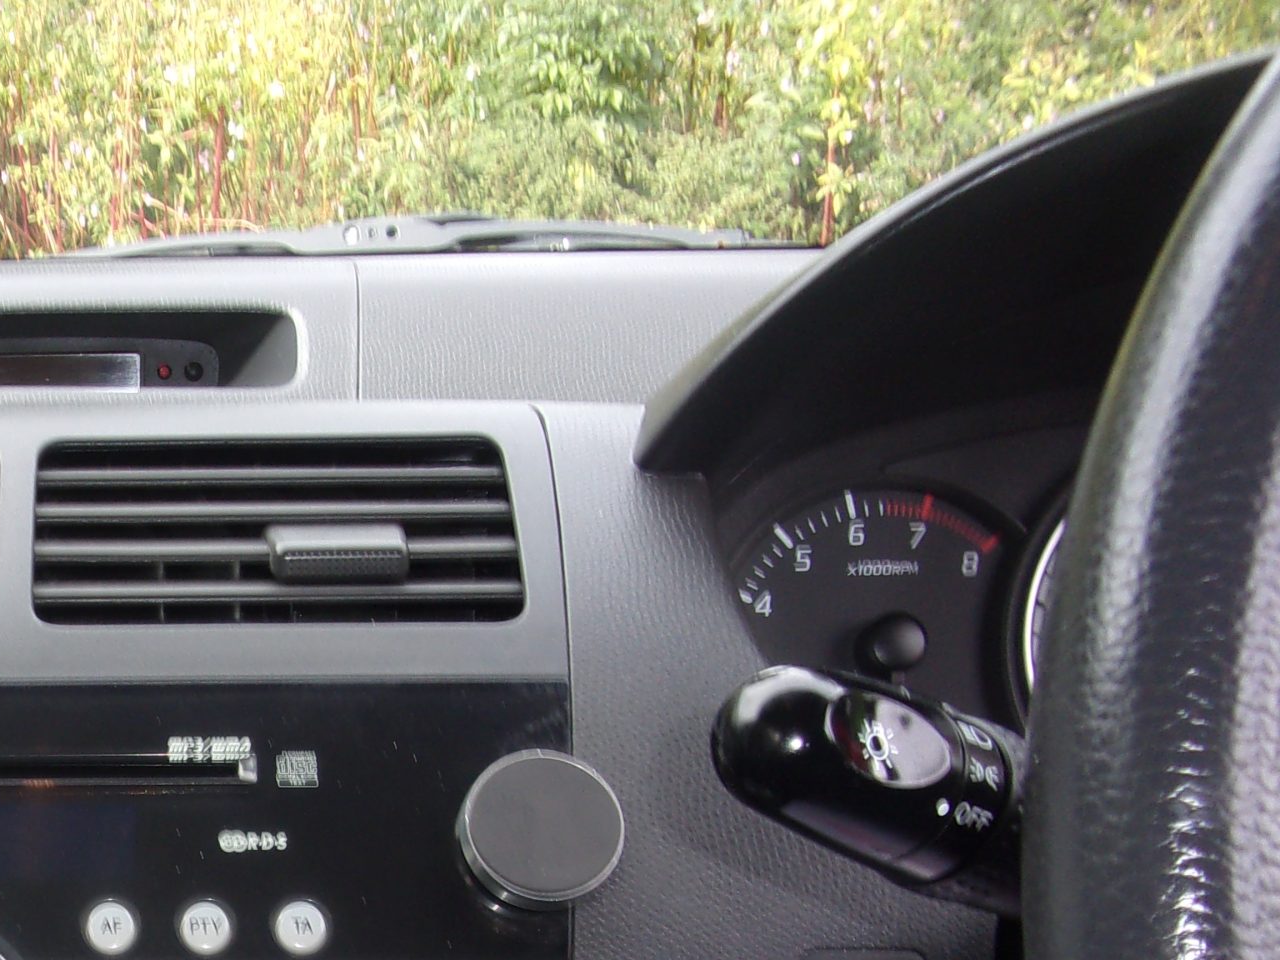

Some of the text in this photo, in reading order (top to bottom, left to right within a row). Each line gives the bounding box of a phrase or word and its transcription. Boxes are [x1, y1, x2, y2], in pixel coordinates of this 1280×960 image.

[849, 519, 866, 546] 6
[909, 521, 927, 550] 7
[794, 546, 814, 573] 5
[962, 550, 979, 578] 8
[754, 589, 773, 617] 4
[954, 801, 994, 832] OFF
[101, 916, 123, 937] AF
[291, 915, 315, 936] TA
